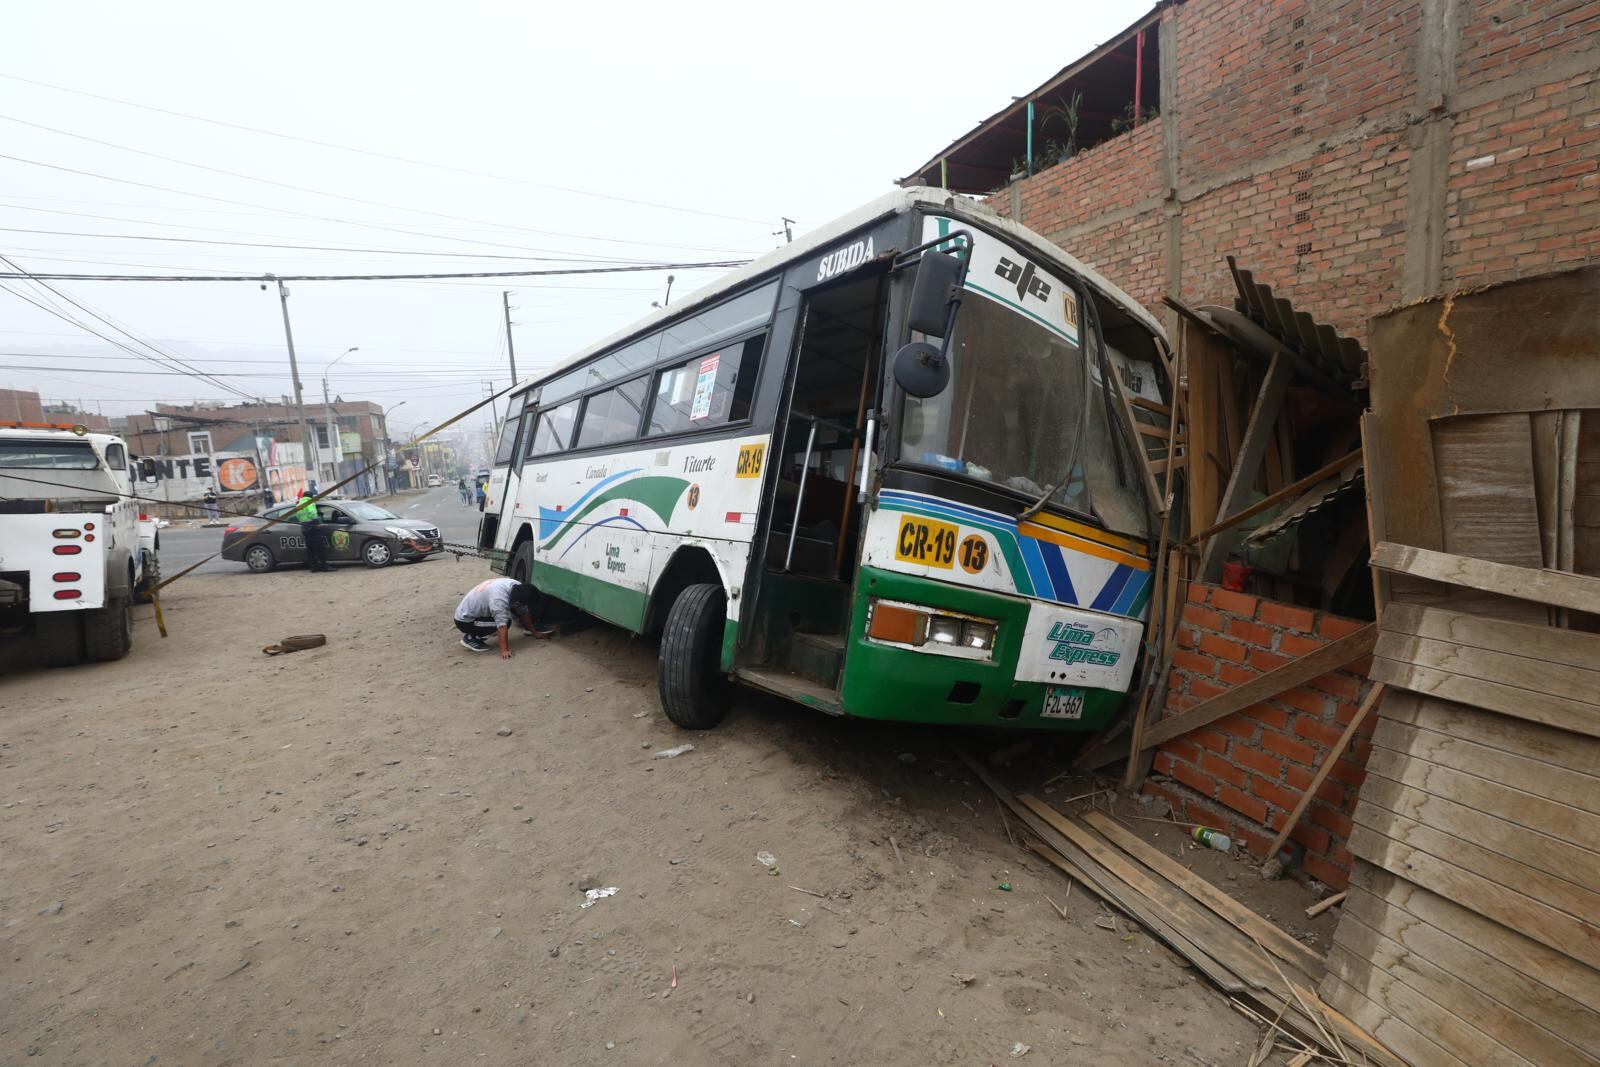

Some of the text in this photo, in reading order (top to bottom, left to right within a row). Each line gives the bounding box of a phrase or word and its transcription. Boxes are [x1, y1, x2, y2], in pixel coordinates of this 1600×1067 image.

[817, 236, 874, 281] SUBIDA
[683, 455, 717, 473] Vitarte
[737, 448, 763, 474] CR-19
[228, 463, 246, 485] K
[688, 486, 700, 508] 13
[280, 535, 330, 549] POLA
[605, 542, 620, 558] Lima
[900, 522, 956, 564] CR-19
[607, 556, 627, 574] Express
[963, 538, 987, 571] 13
[1047, 621, 1096, 646] Lima
[1048, 640, 1121, 667] Express
[1044, 694, 1083, 715] F2L-667
